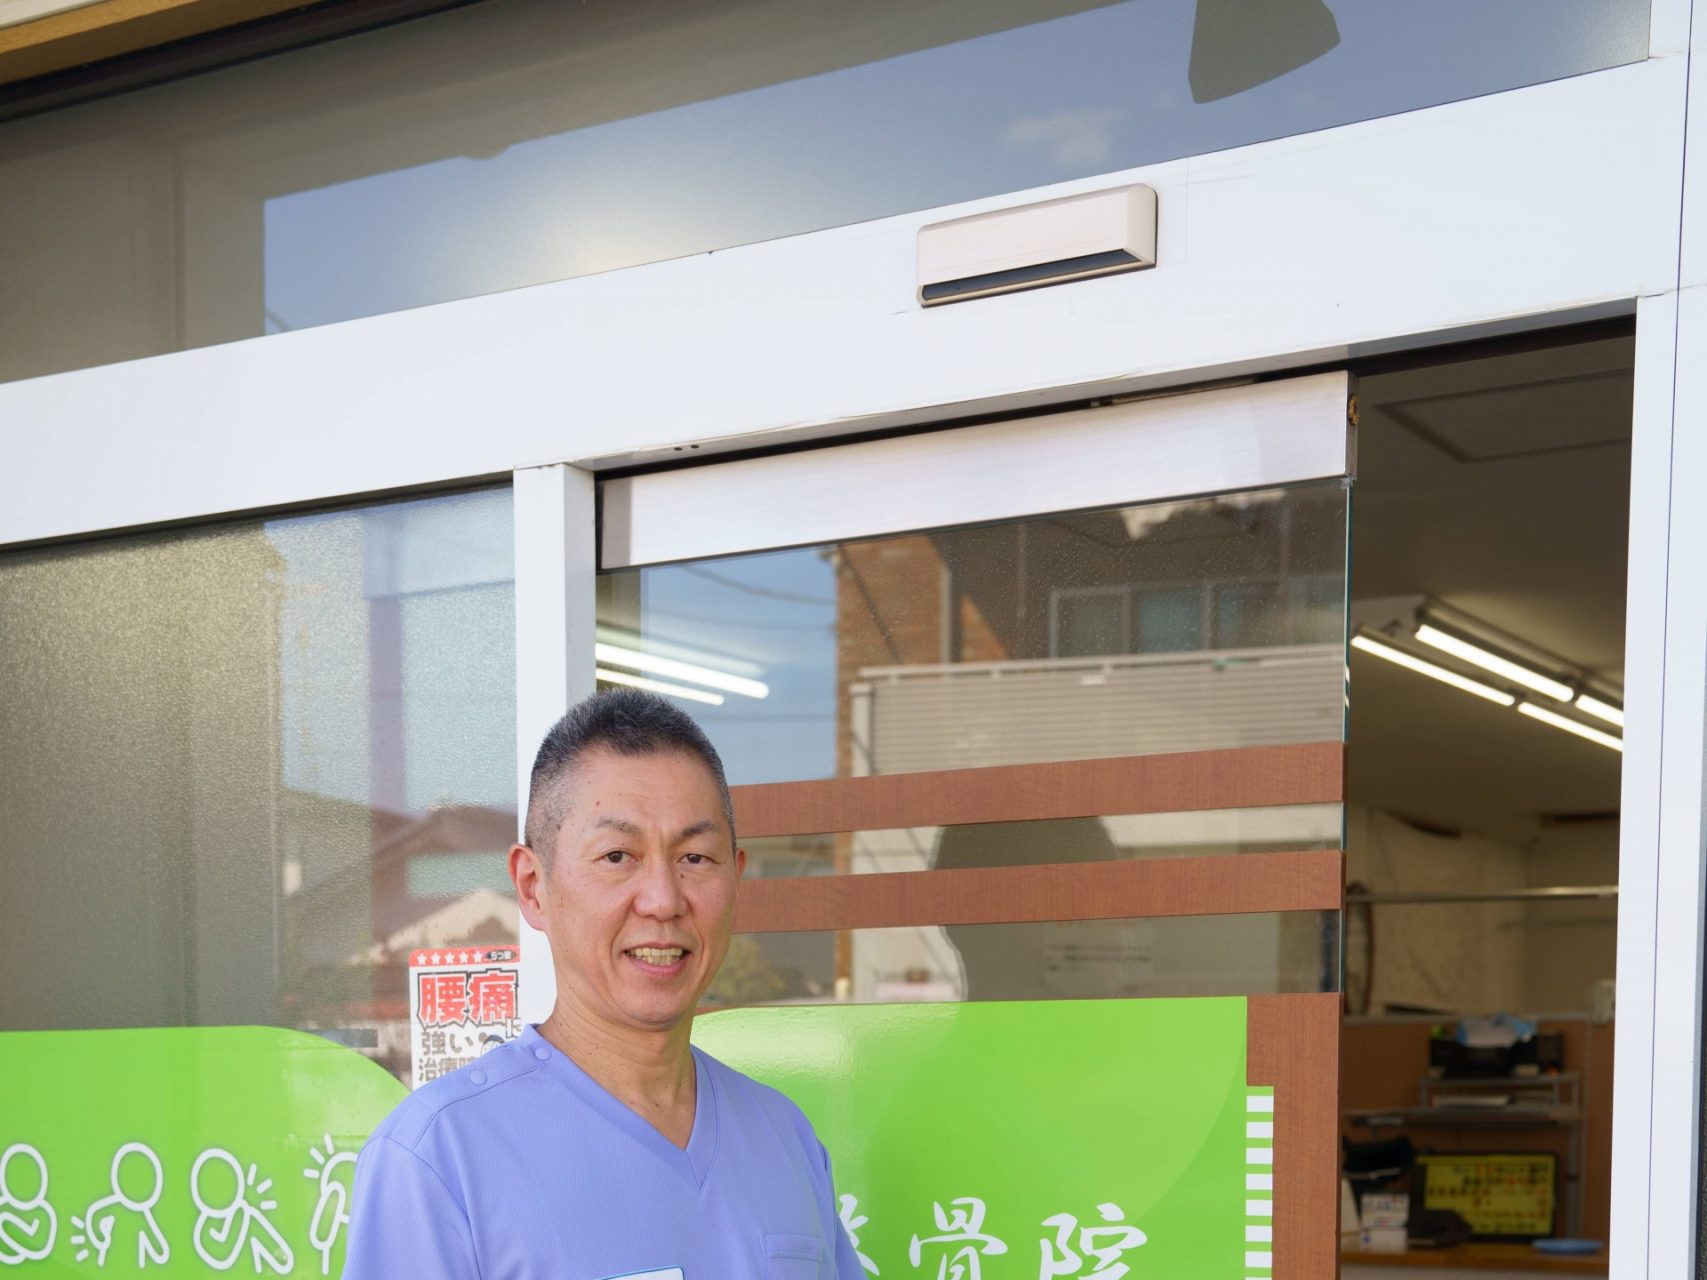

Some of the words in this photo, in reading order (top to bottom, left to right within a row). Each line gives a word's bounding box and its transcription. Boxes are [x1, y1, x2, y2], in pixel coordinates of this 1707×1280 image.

[418, 970, 518, 1026] 腰痛
[421, 1031, 474, 1056] 強い
[418, 1056, 476, 1081] 治療
